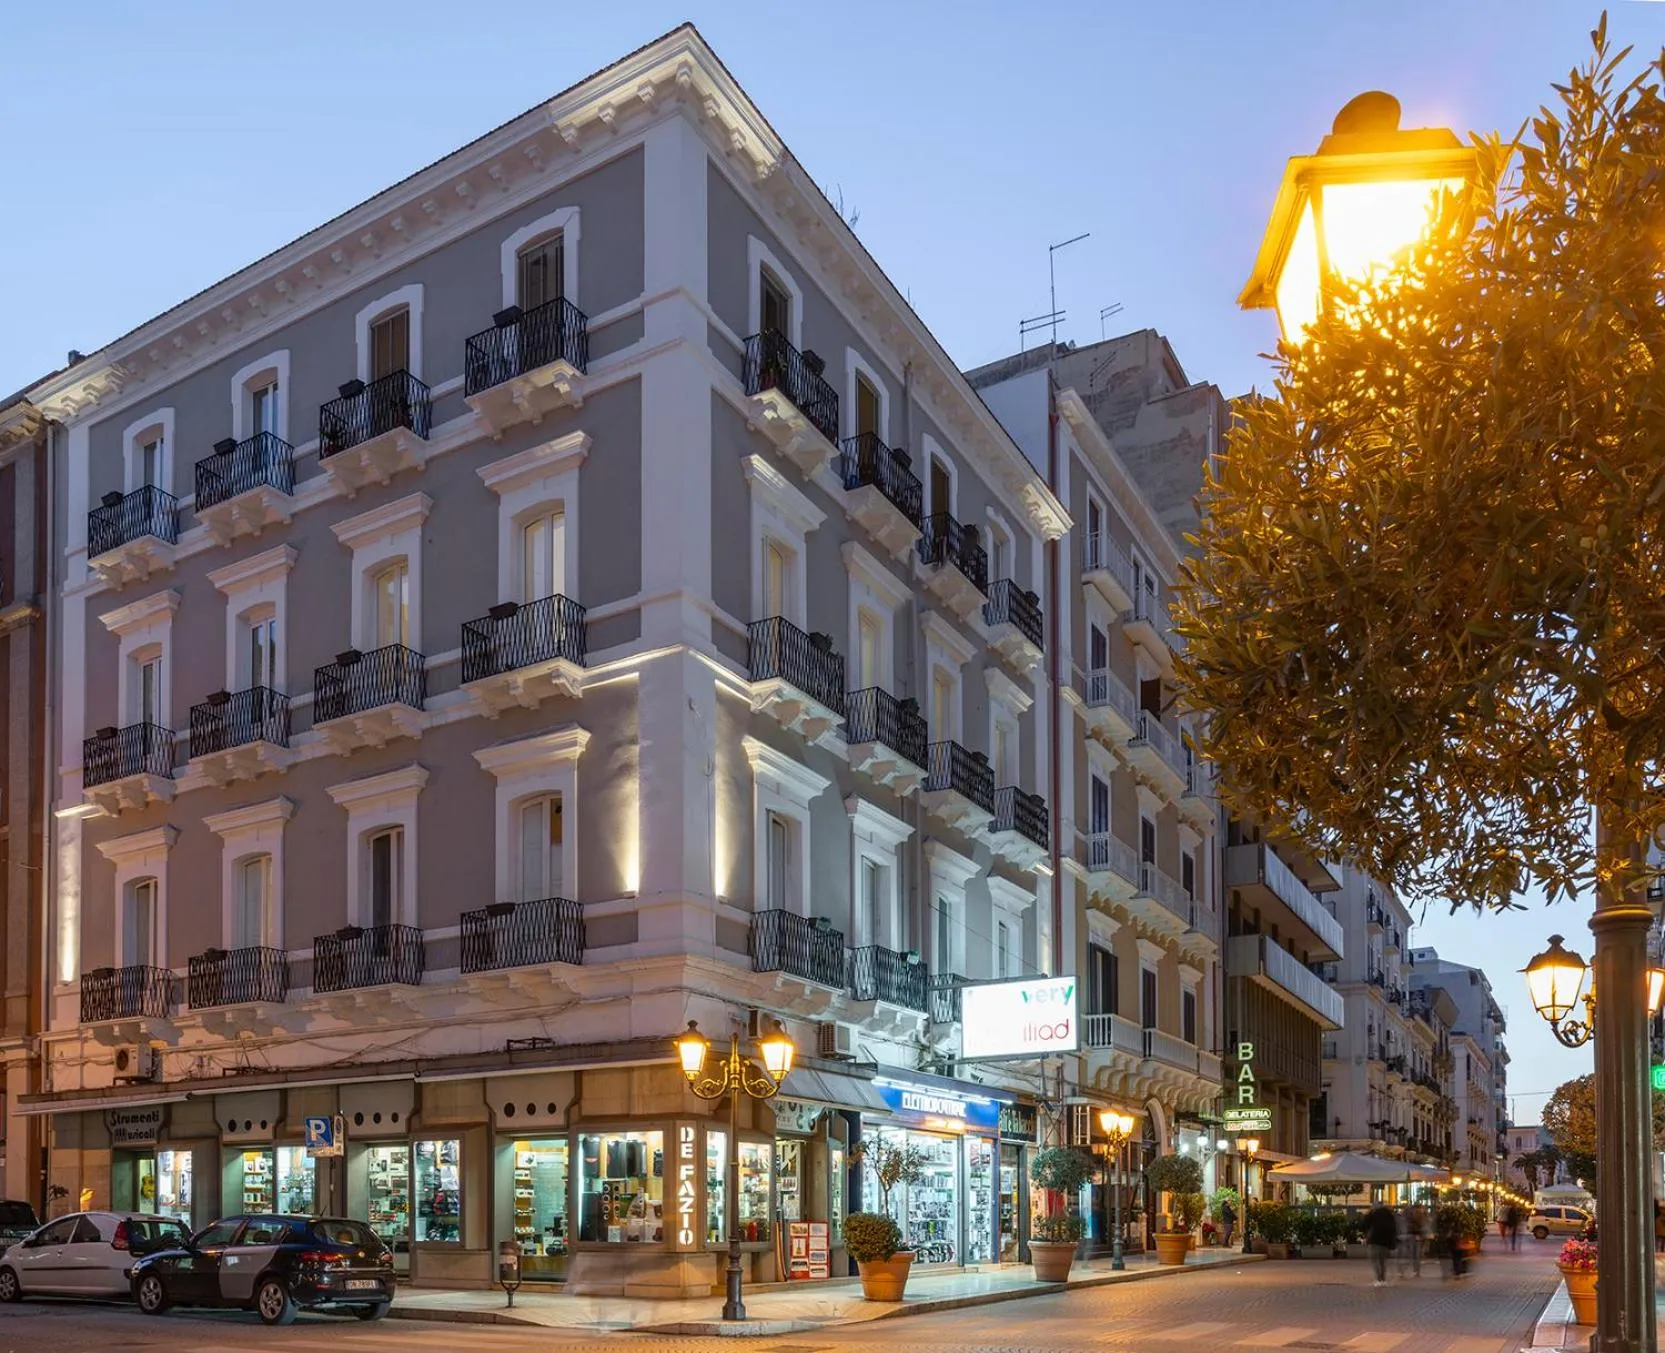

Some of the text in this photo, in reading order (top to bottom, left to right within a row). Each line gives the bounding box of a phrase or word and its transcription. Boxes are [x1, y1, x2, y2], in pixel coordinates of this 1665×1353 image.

[1021, 984, 1074, 1006] very
[1023, 1018, 1070, 1042] iliad
[1238, 1042, 1255, 1104] BAR
[110, 1110, 160, 1126] Strumenti
[1225, 1111, 1269, 1120] GELATERIA
[309, 1119, 326, 1141] P
[678, 1126, 696, 1246] DE FAZIO
